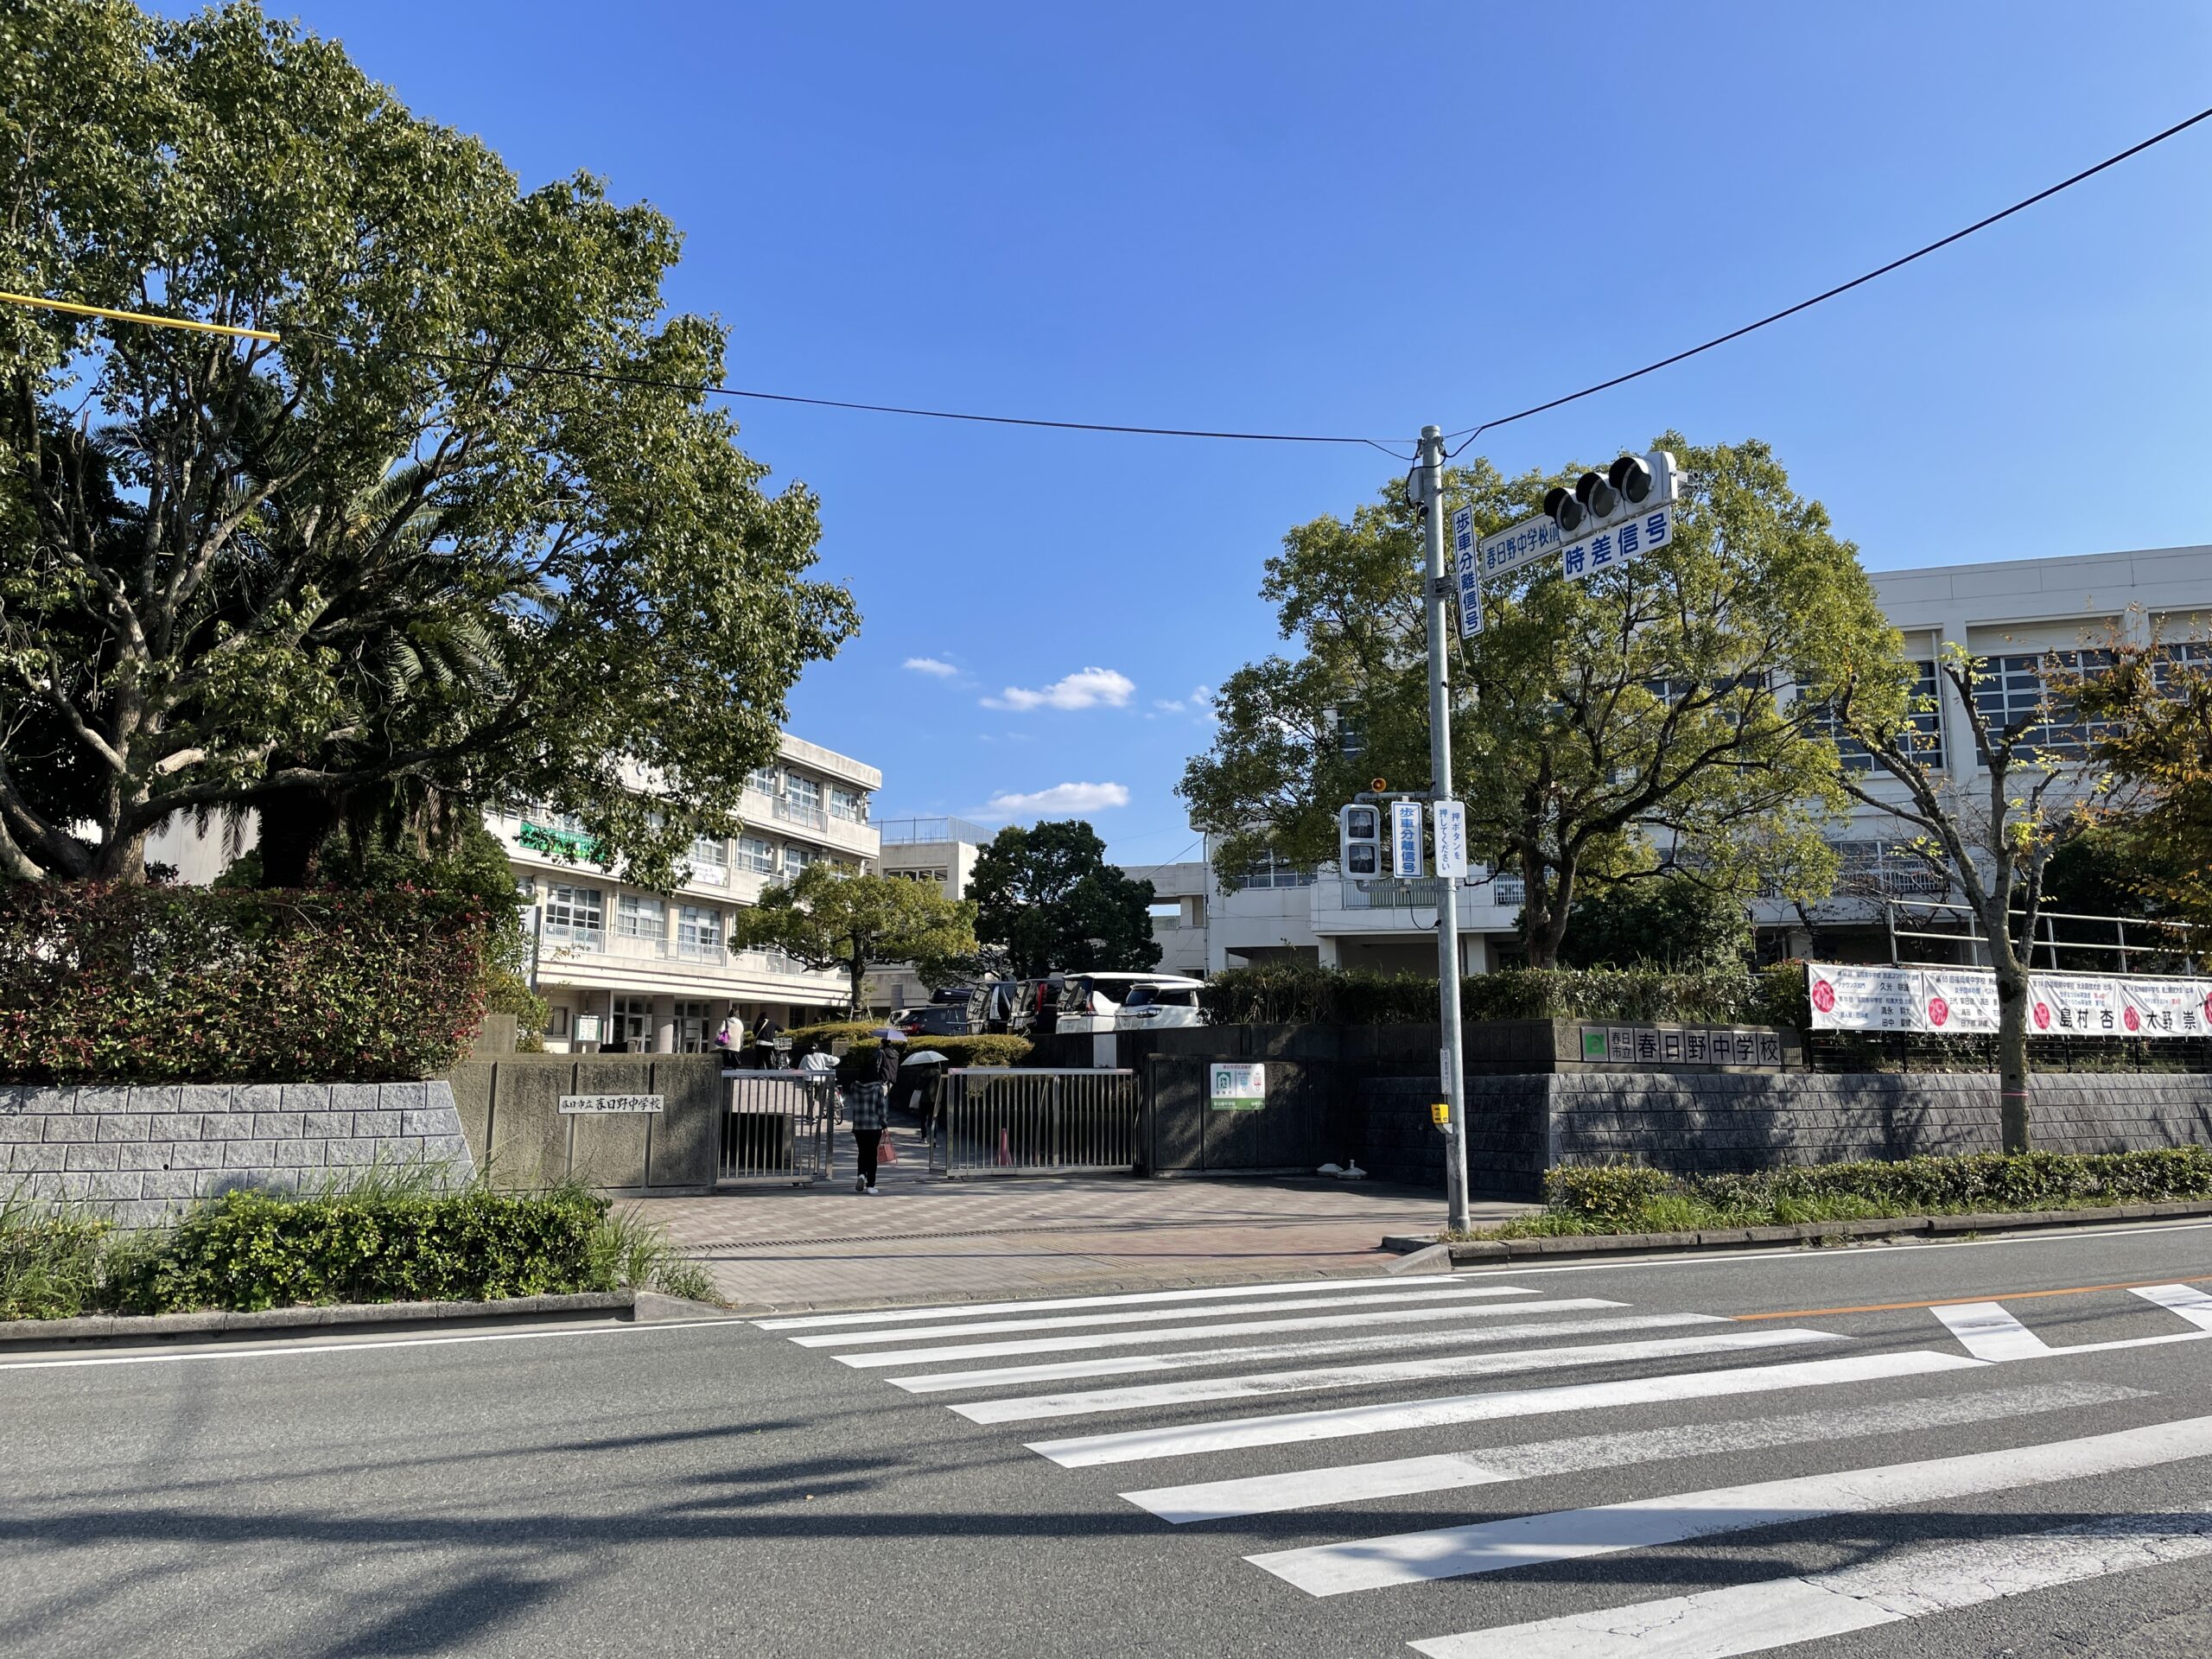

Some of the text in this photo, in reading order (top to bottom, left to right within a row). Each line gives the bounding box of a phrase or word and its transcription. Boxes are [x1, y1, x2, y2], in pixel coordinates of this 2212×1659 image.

[1566, 512, 1668, 575] 時差信号
[1456, 512, 1479, 631] 歩車分離信号
[1400, 807, 1415, 873] 歩車分離信号
[1439, 809, 1450, 870] 押してください
[1452, 812, 1460, 859] 押ボタンを
[1882, 1018, 1895, 1027] 田中
[2060, 1007, 2114, 1028] 島村 杏
[2146, 1010, 2172, 1030] 大野
[1611, 1032, 1630, 1045] 春日
[1612, 1046, 1631, 1059] 市立
[1638, 1033, 1778, 1061] 春日野中学校
